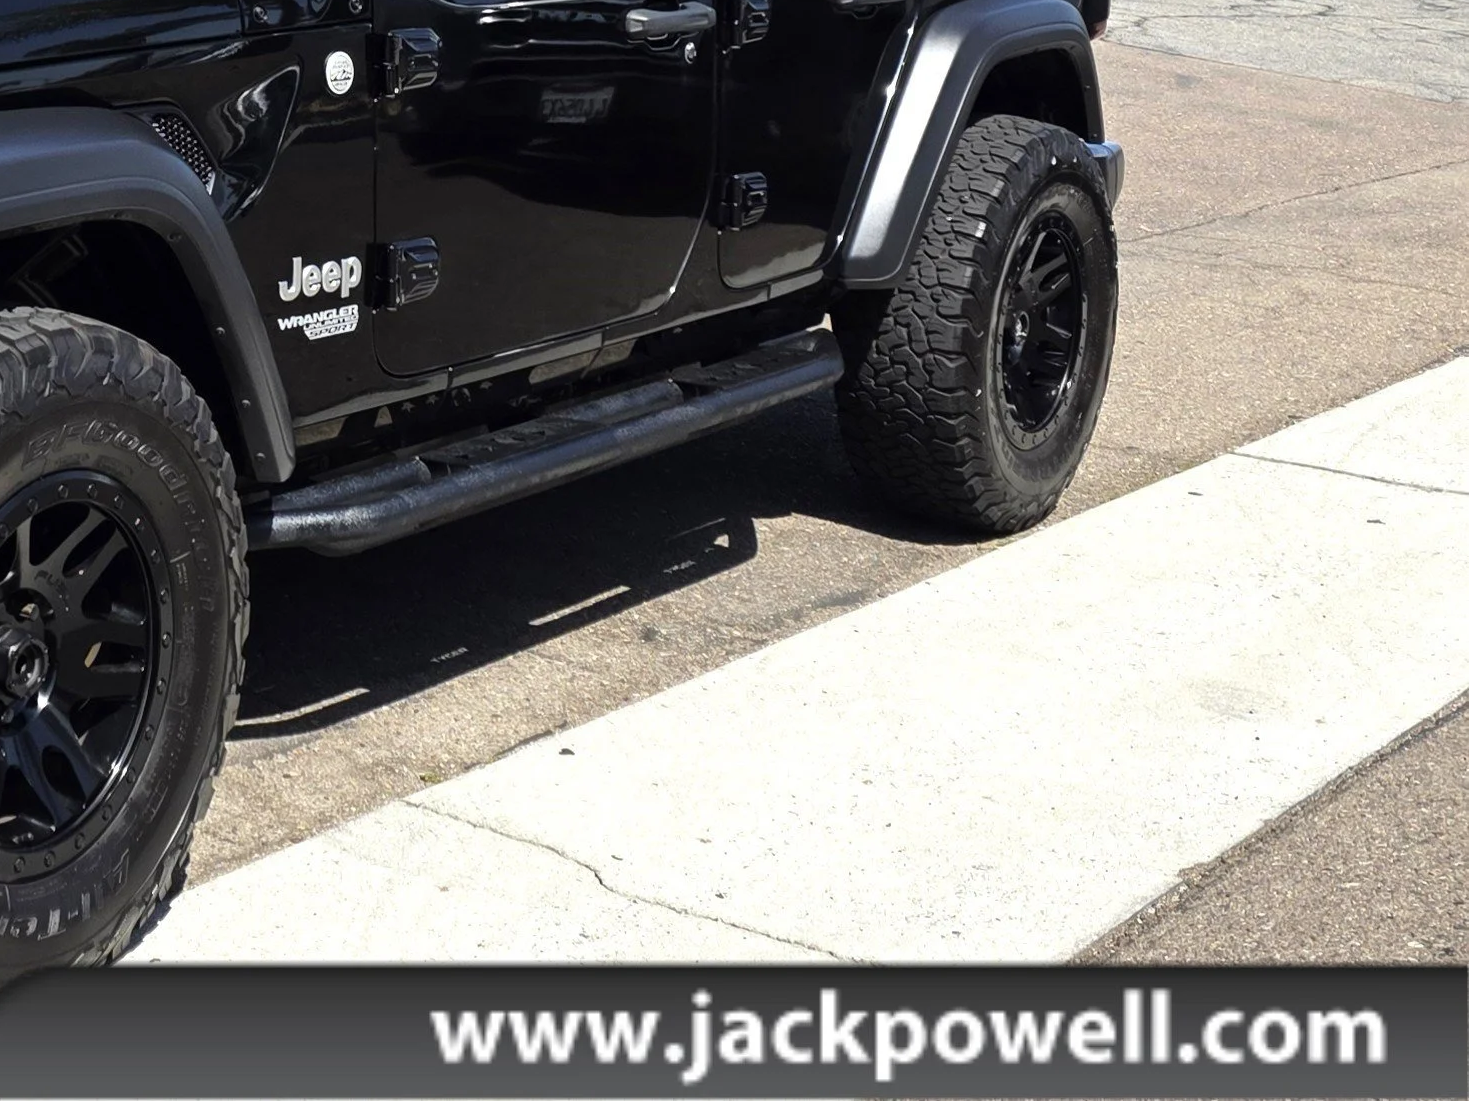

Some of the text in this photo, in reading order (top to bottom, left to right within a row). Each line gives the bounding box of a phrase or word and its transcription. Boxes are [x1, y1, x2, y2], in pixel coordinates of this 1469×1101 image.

[278, 256, 362, 302] Jeep
[277, 304, 359, 331] WRANGLER
[309, 323, 356, 338] SPORT
